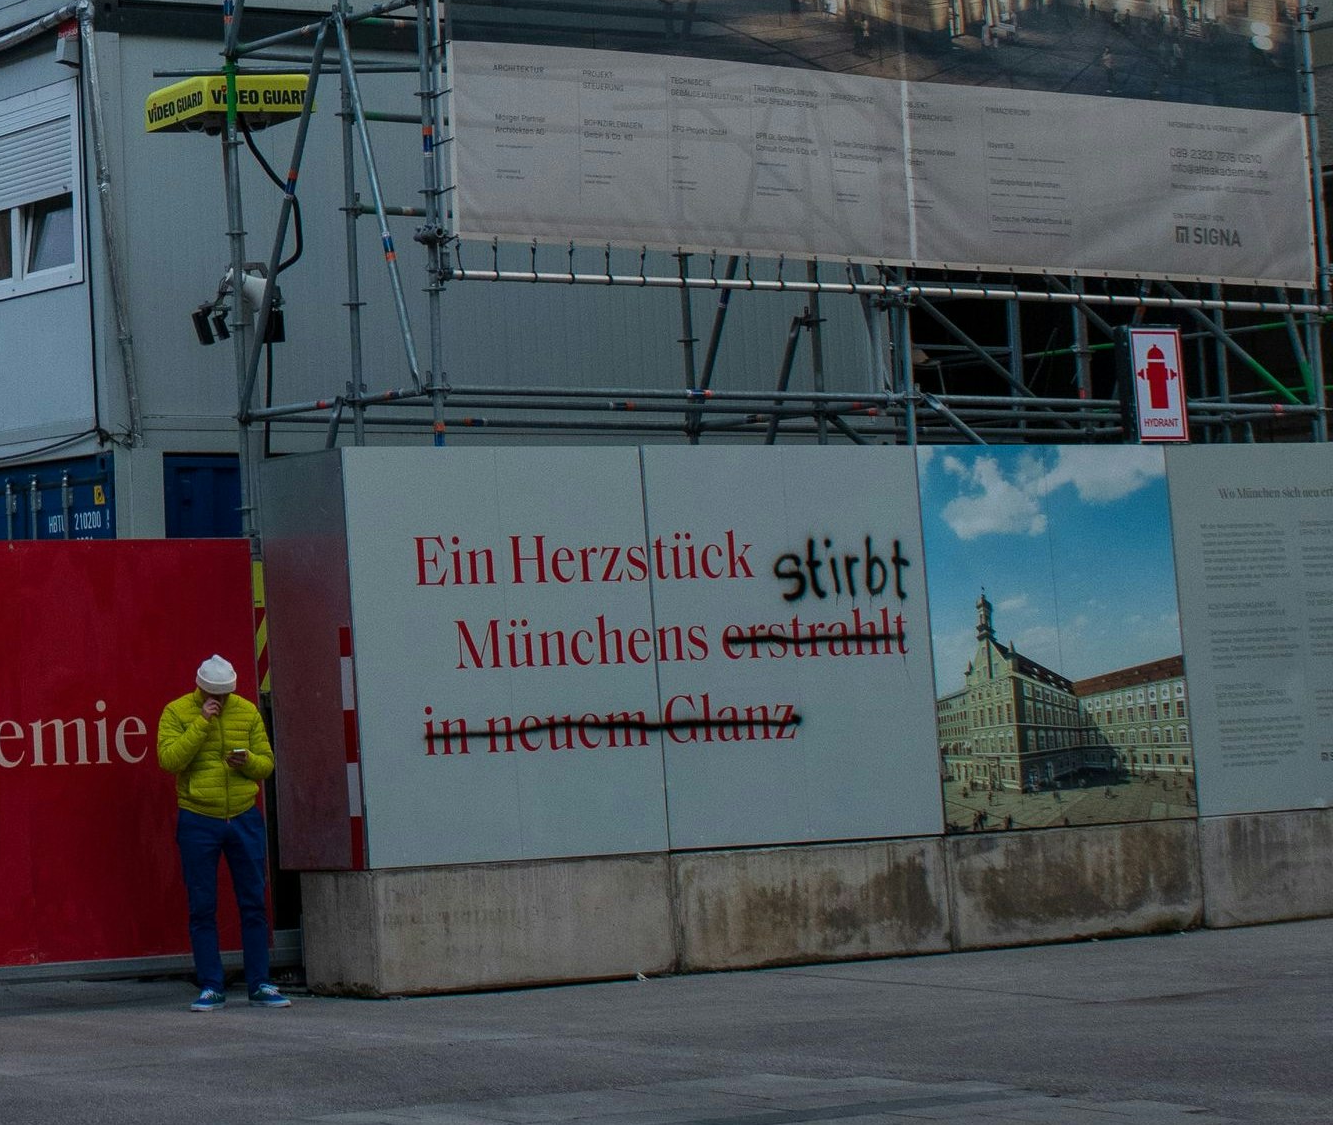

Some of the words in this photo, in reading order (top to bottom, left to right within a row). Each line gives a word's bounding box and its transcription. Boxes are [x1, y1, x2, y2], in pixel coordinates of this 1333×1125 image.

[492, 64, 545, 74] ARCHITEKTUR
[582, 70, 614, 79] PROJEKT
[582, 82, 624, 92] STEUERUNG
[176, 91, 203, 114] GUARD
[1193, 226, 1242, 248] SIGNA
[1144, 418, 1178, 427] HYDRANT
[74, 510, 101, 531] 210200
[415, 535, 495, 588] Ein
[510, 529, 755, 585] Herzstück
[773, 536, 911, 603] stirbt
[455, 617, 710, 671] Münchens
[723, 607, 910, 661] erstrahlt
[424, 706, 472, 757] in
[485, 708, 650, 753] neuem
[664, 691, 798, 745] Glanz
